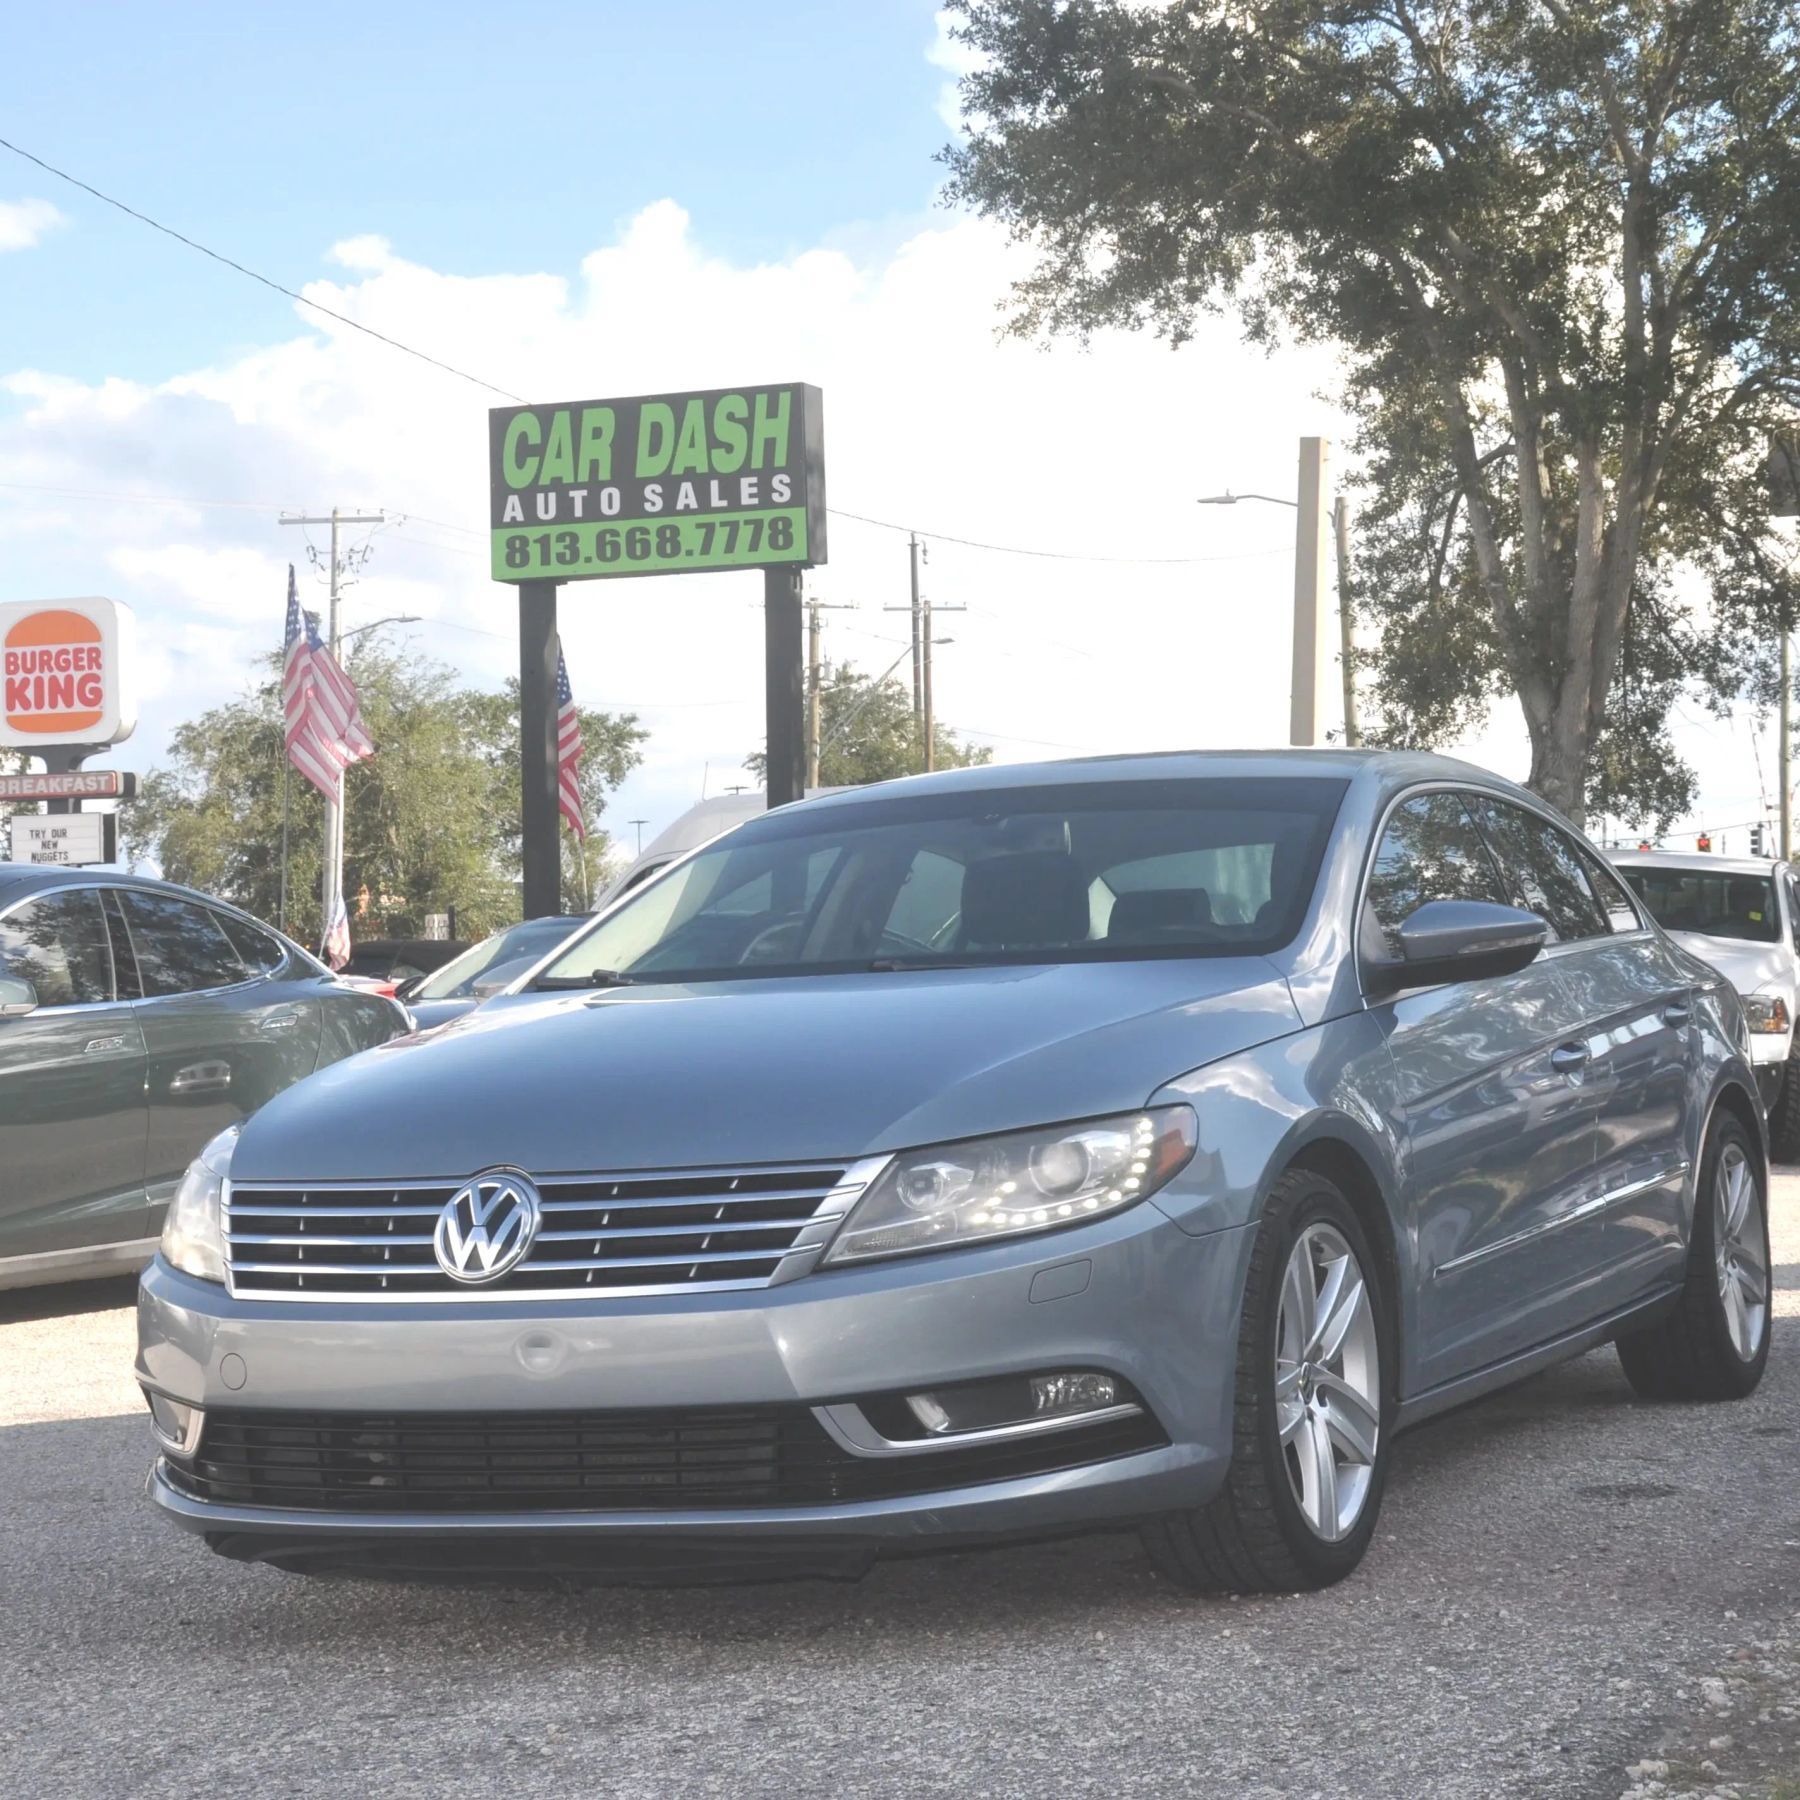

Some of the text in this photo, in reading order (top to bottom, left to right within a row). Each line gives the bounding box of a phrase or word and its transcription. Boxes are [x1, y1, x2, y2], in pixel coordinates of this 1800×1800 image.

[502, 391, 792, 490] CAR DASH
[502, 473, 792, 523] AUTO SALES
[505, 516, 794, 569] 813.668.7778
[5, 646, 103, 676] BURGER
[5, 672, 104, 713] KING
[29, 828, 68, 839] TRY OUR
[41, 840, 59, 850] NEW
[31, 851, 69, 864] NUGGETS
